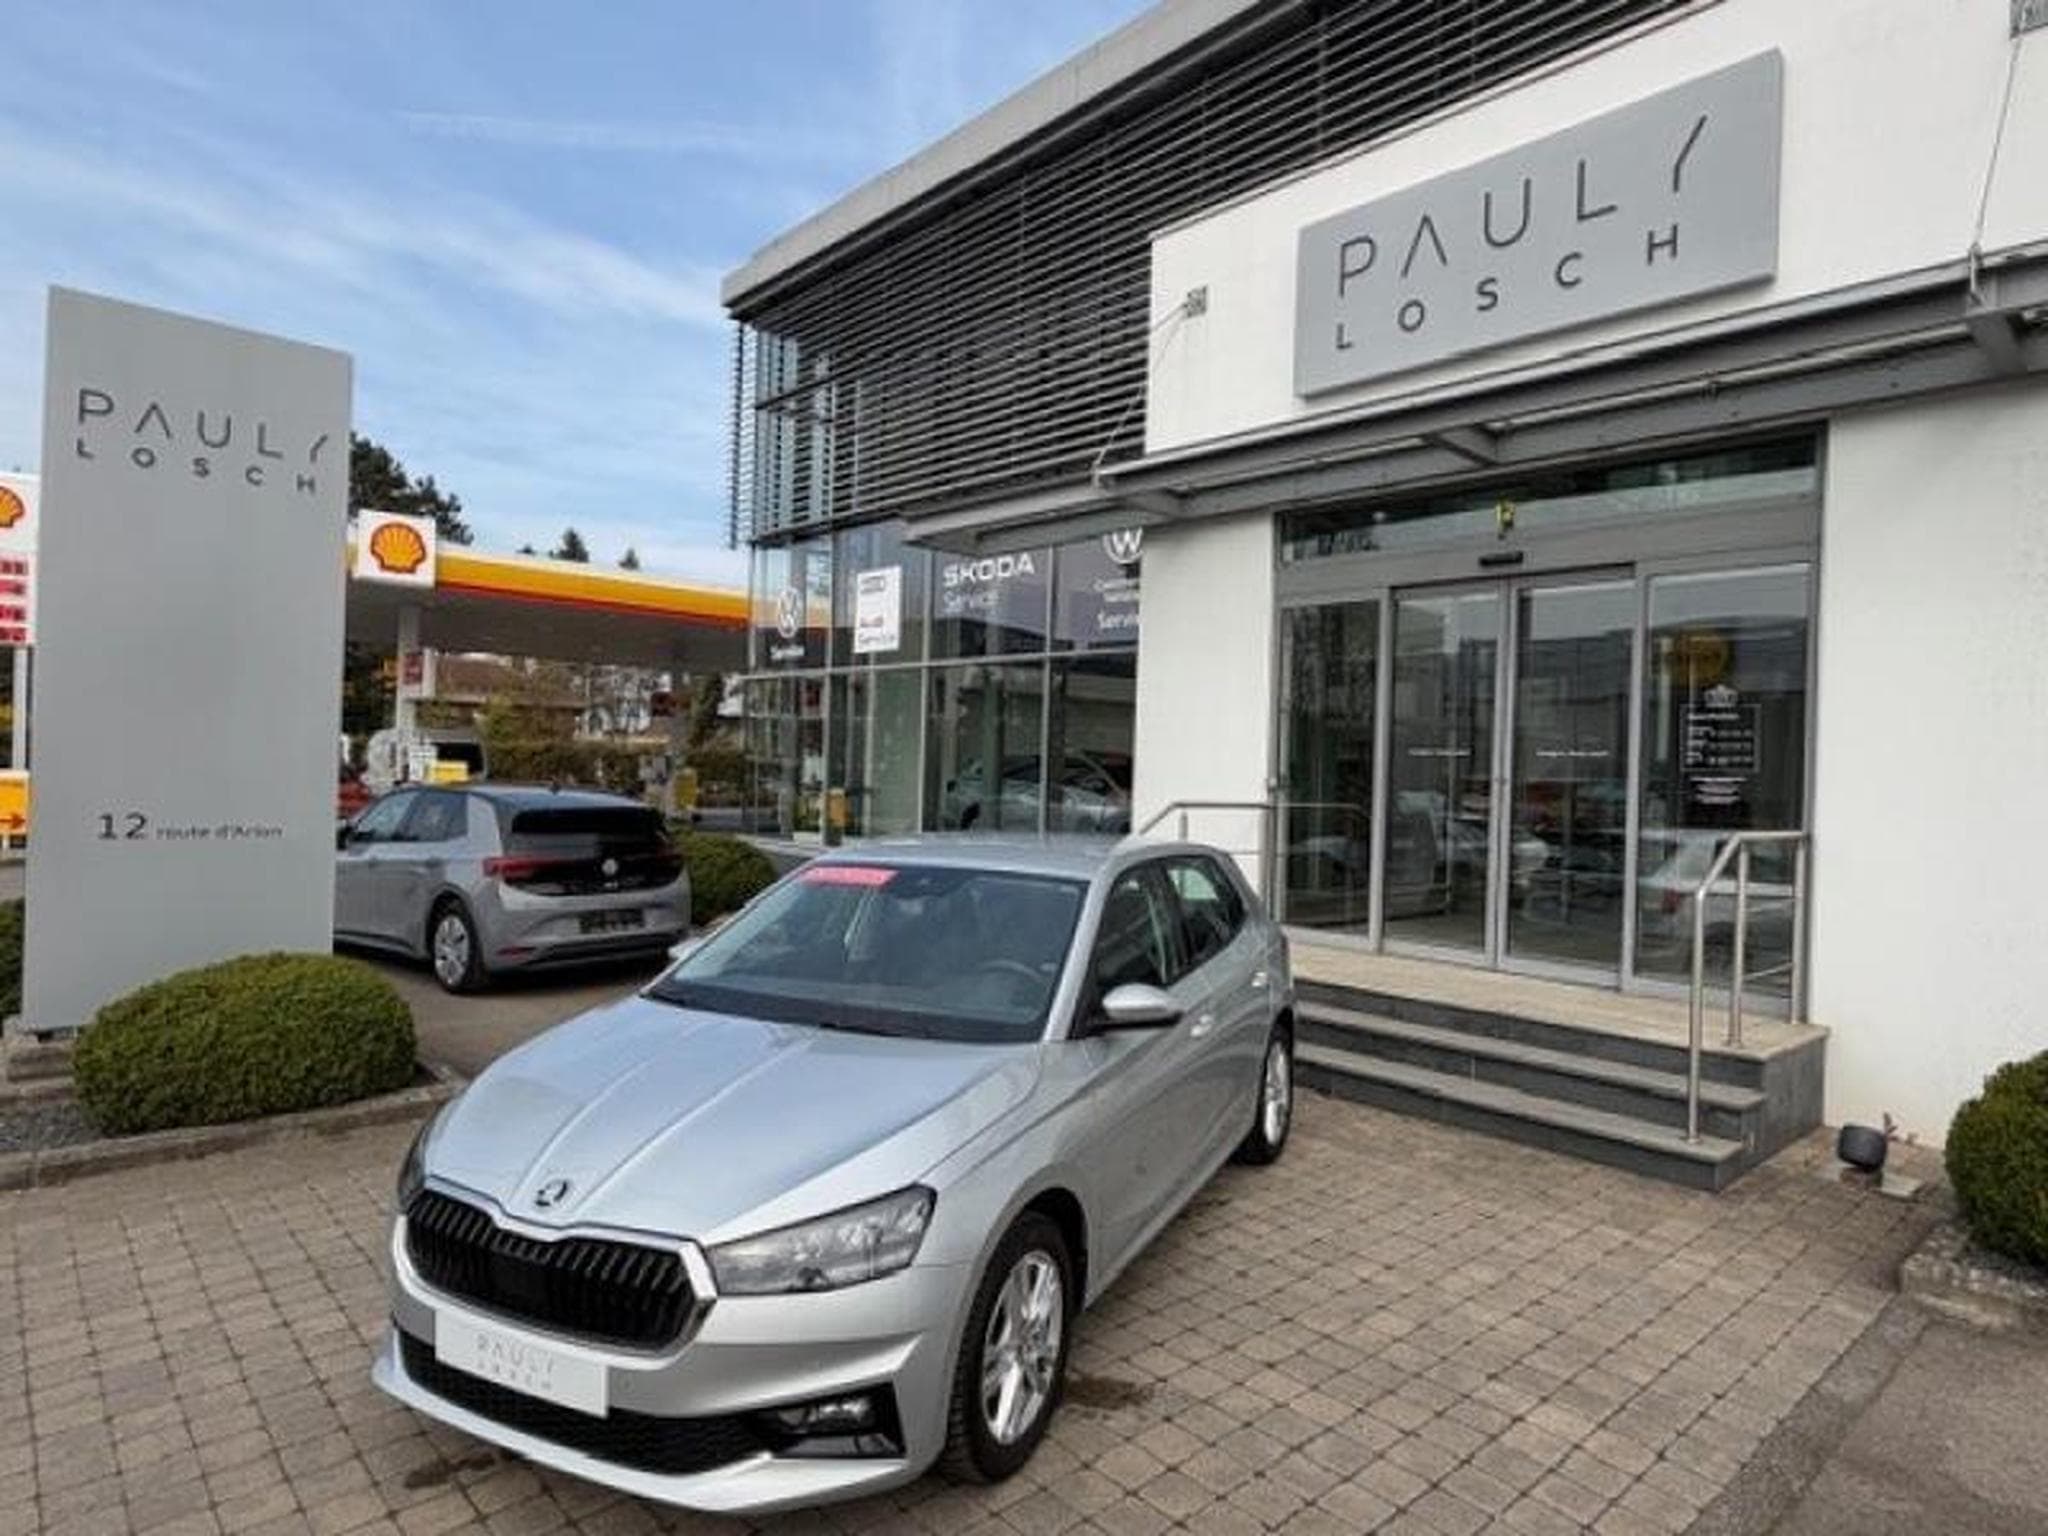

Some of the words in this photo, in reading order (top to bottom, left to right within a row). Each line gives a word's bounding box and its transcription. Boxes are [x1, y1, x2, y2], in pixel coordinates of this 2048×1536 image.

[1338, 114, 1707, 298] PAULY
[1336, 222, 1679, 350] LOSCH
[78, 387, 329, 464] PAULY
[76, 438, 316, 495] LOSCH
[98, 812, 148, 840] 12
